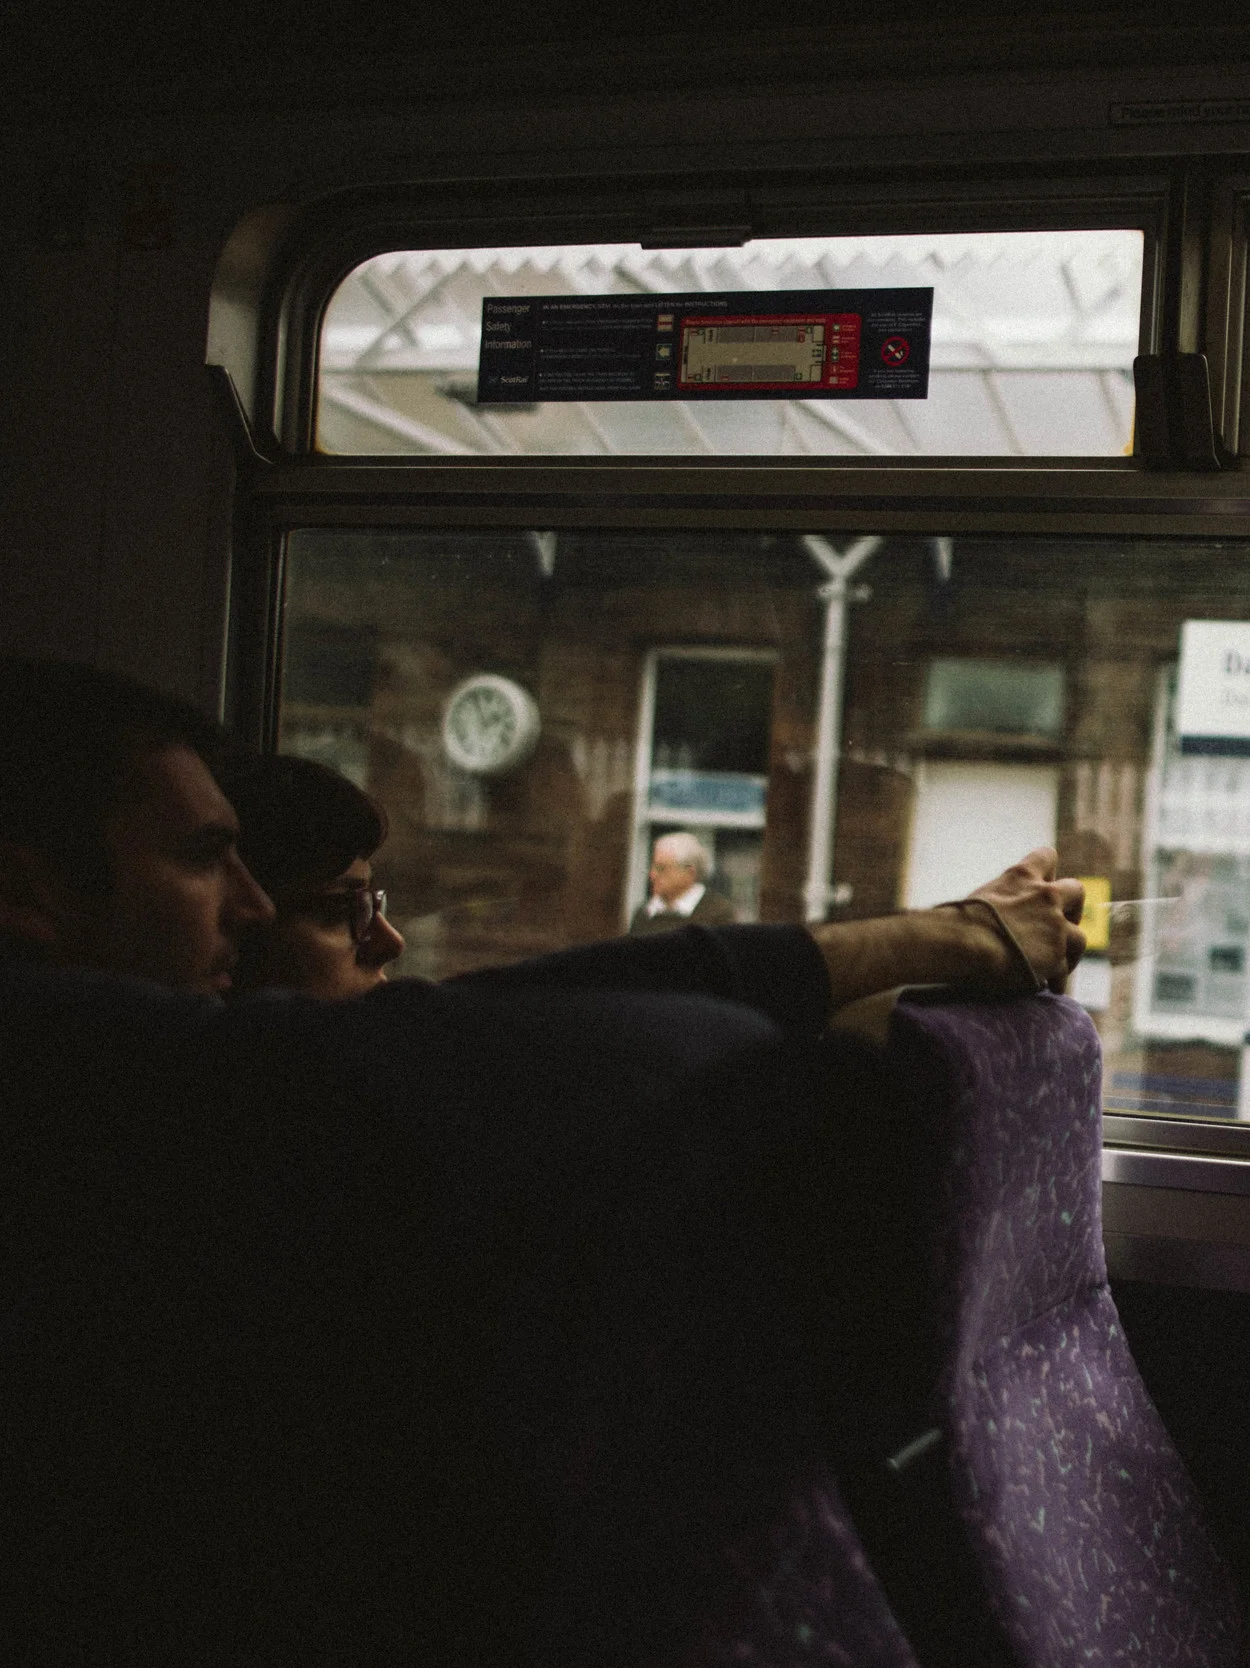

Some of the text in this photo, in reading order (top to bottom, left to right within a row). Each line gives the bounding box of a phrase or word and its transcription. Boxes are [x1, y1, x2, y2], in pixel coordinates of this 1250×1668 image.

[487, 303, 531, 315] Passenger
[486, 321, 512, 333] Safety
[485, 339, 532, 349] Information
